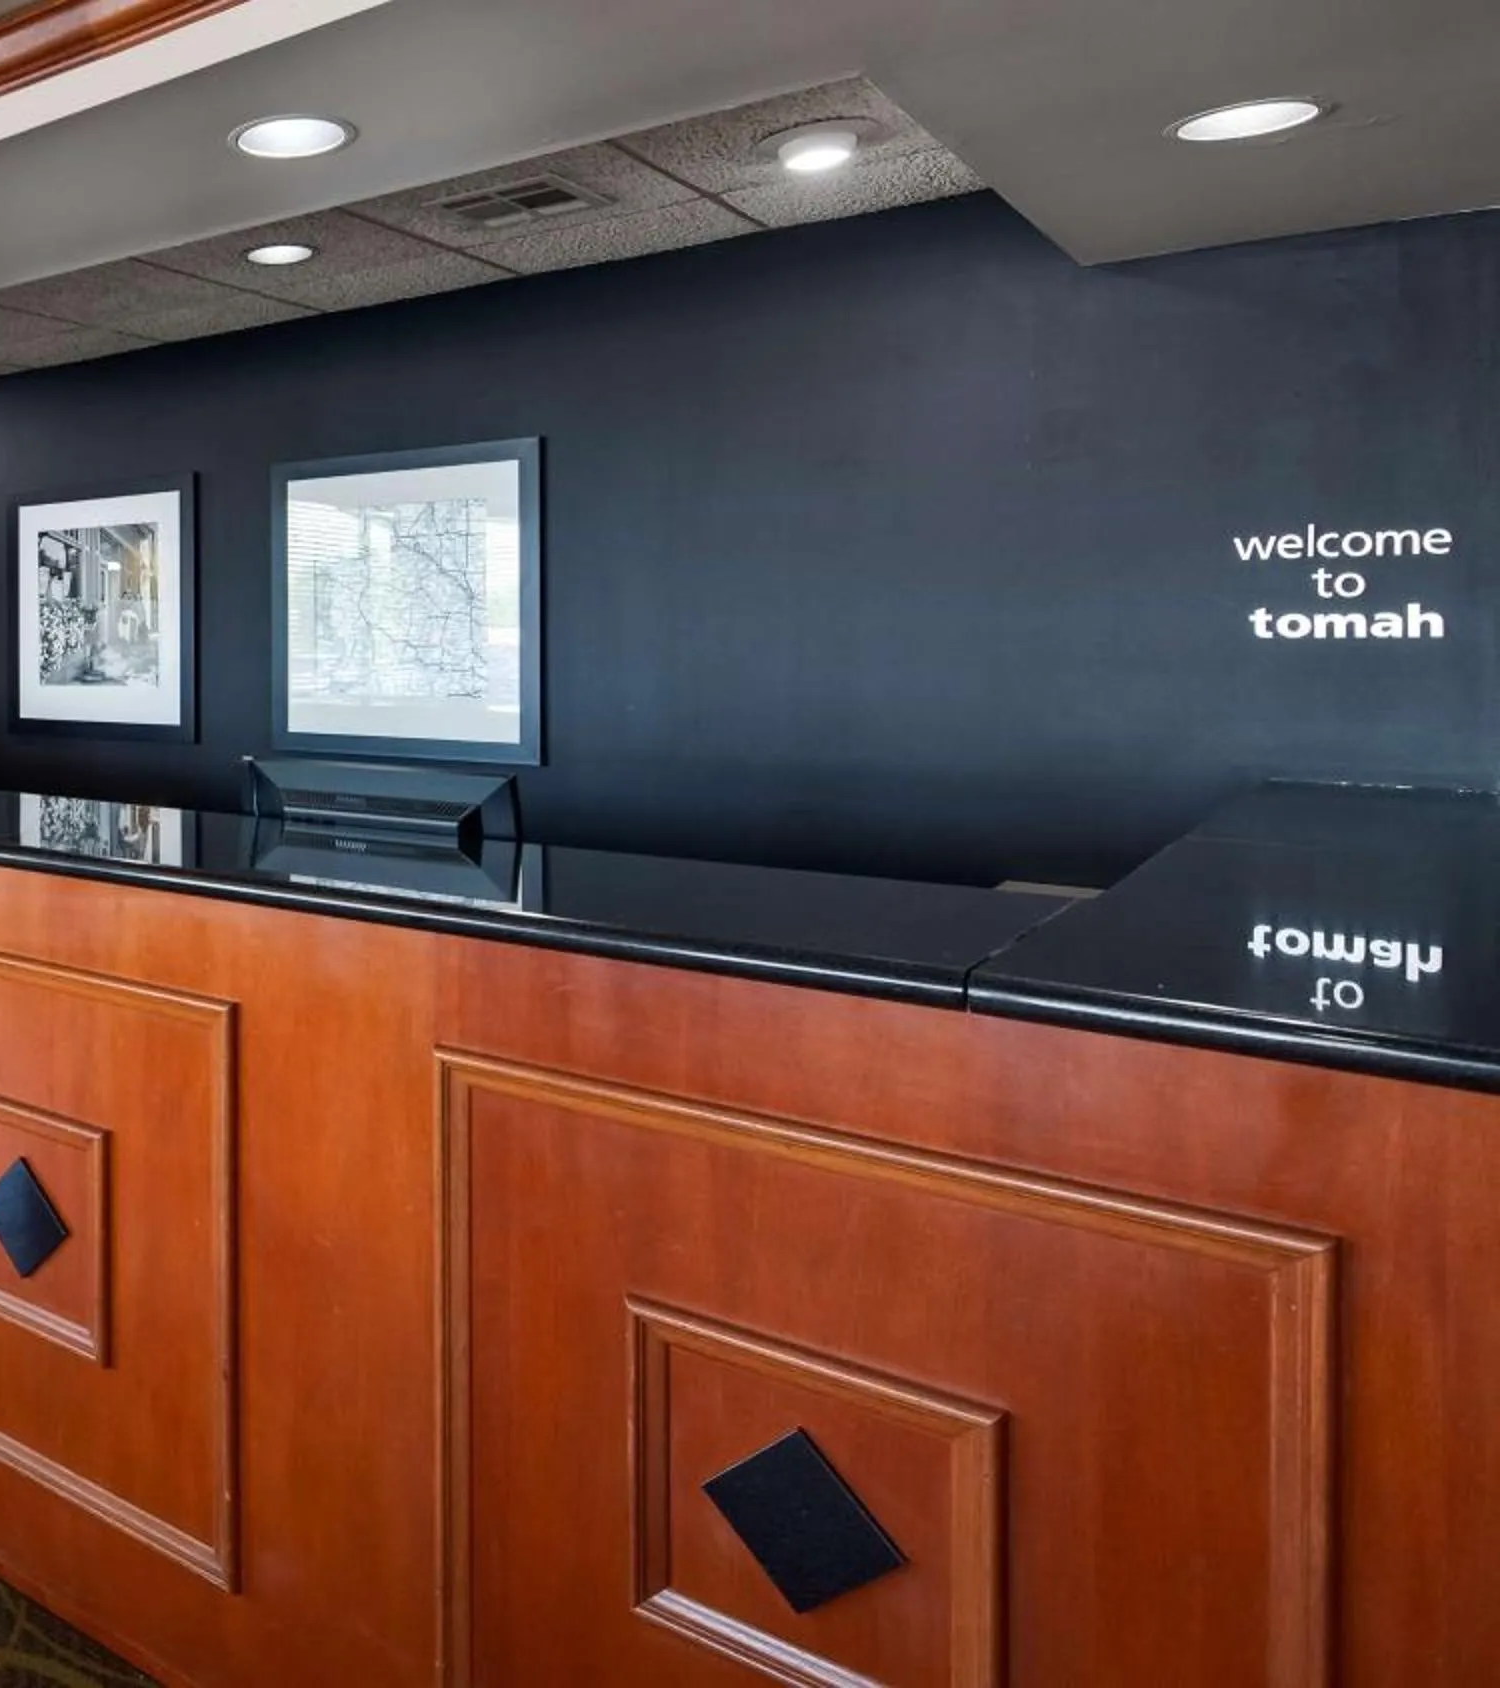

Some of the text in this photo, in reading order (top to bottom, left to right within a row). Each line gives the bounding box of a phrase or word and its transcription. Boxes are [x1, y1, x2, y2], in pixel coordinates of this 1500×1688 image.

[1233, 523, 1453, 561] welcome
[1311, 567, 1366, 598] to
[1248, 603, 1444, 639] tomah
